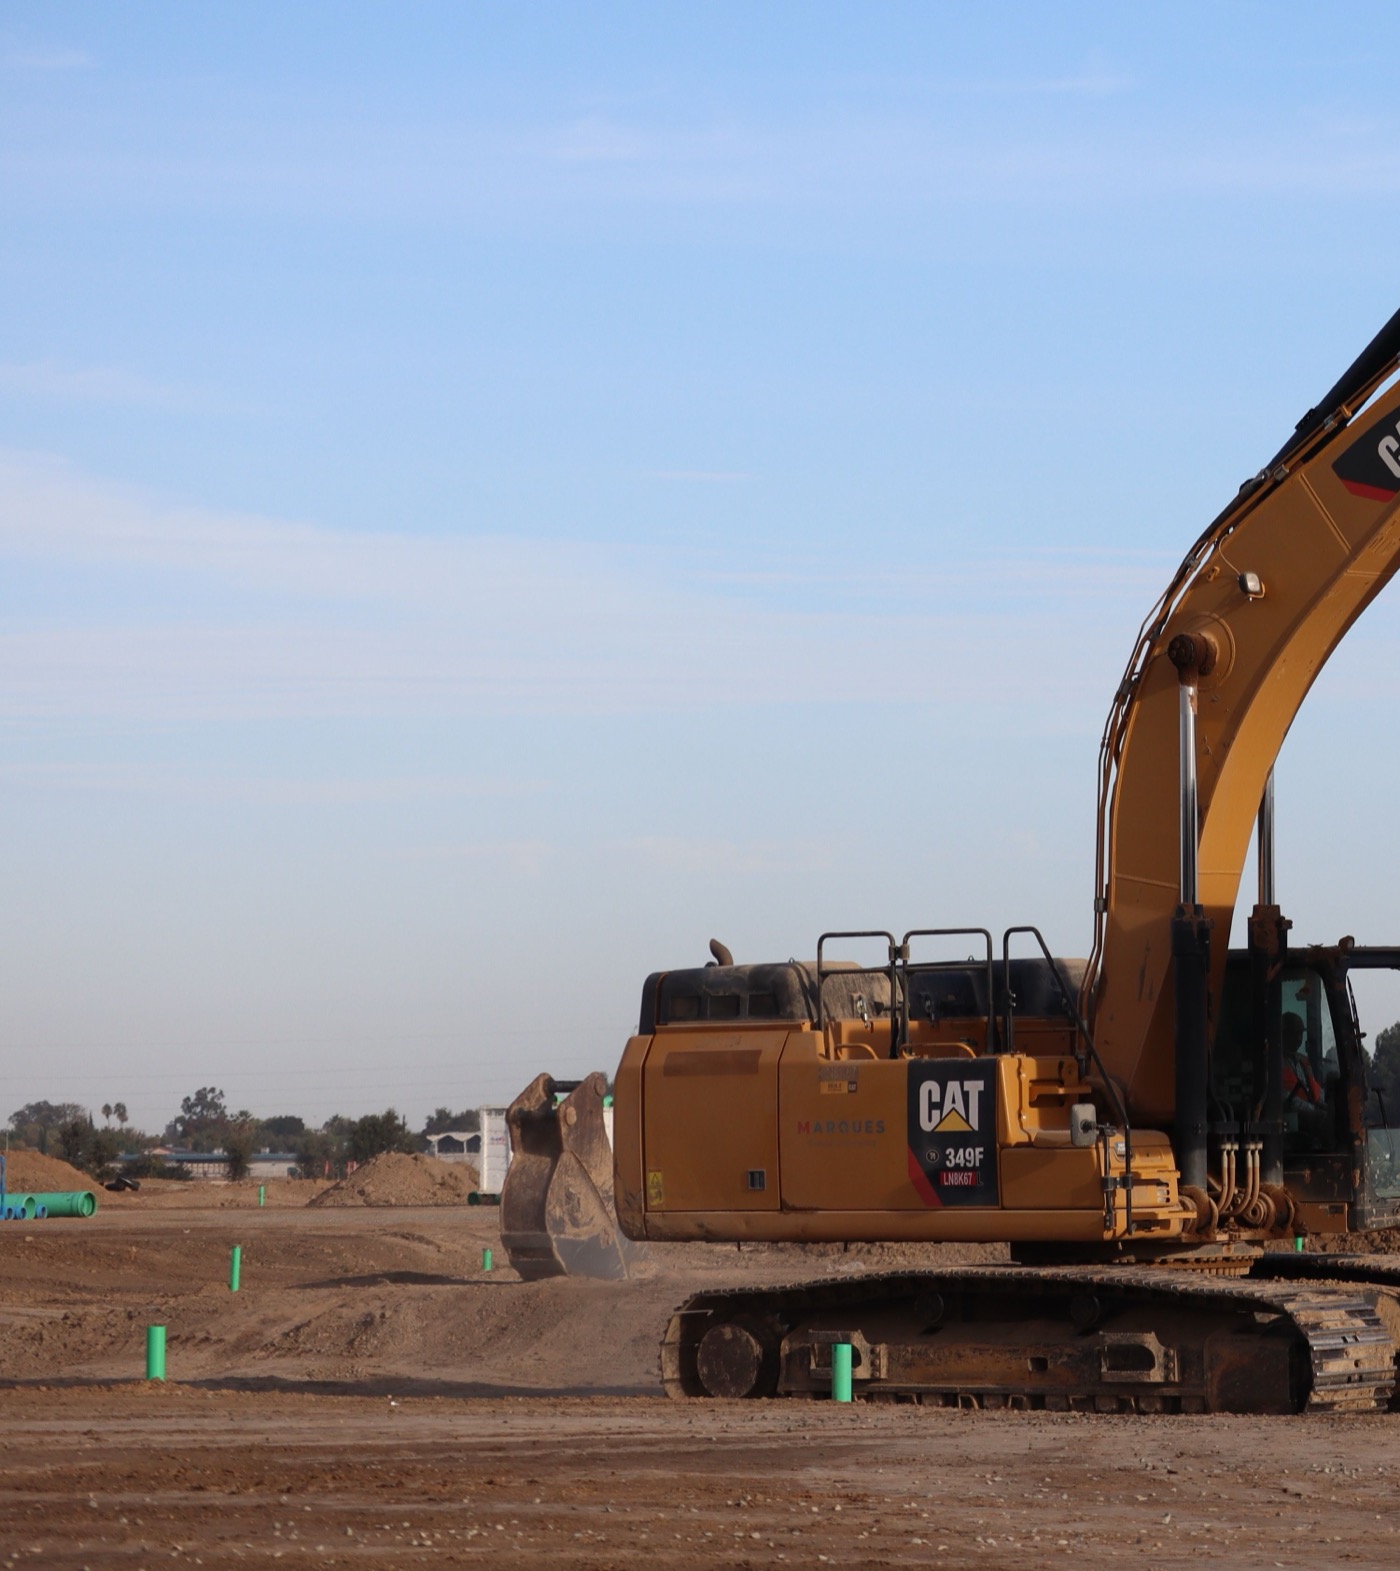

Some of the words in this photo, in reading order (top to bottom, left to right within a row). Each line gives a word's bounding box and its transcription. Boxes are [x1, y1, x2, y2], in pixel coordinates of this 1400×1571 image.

[919, 1080, 984, 1132] CAT
[798, 1120, 885, 1134] MARQUES
[945, 1147, 984, 1168] 349F
[943, 1172, 973, 1186] LN8K67
